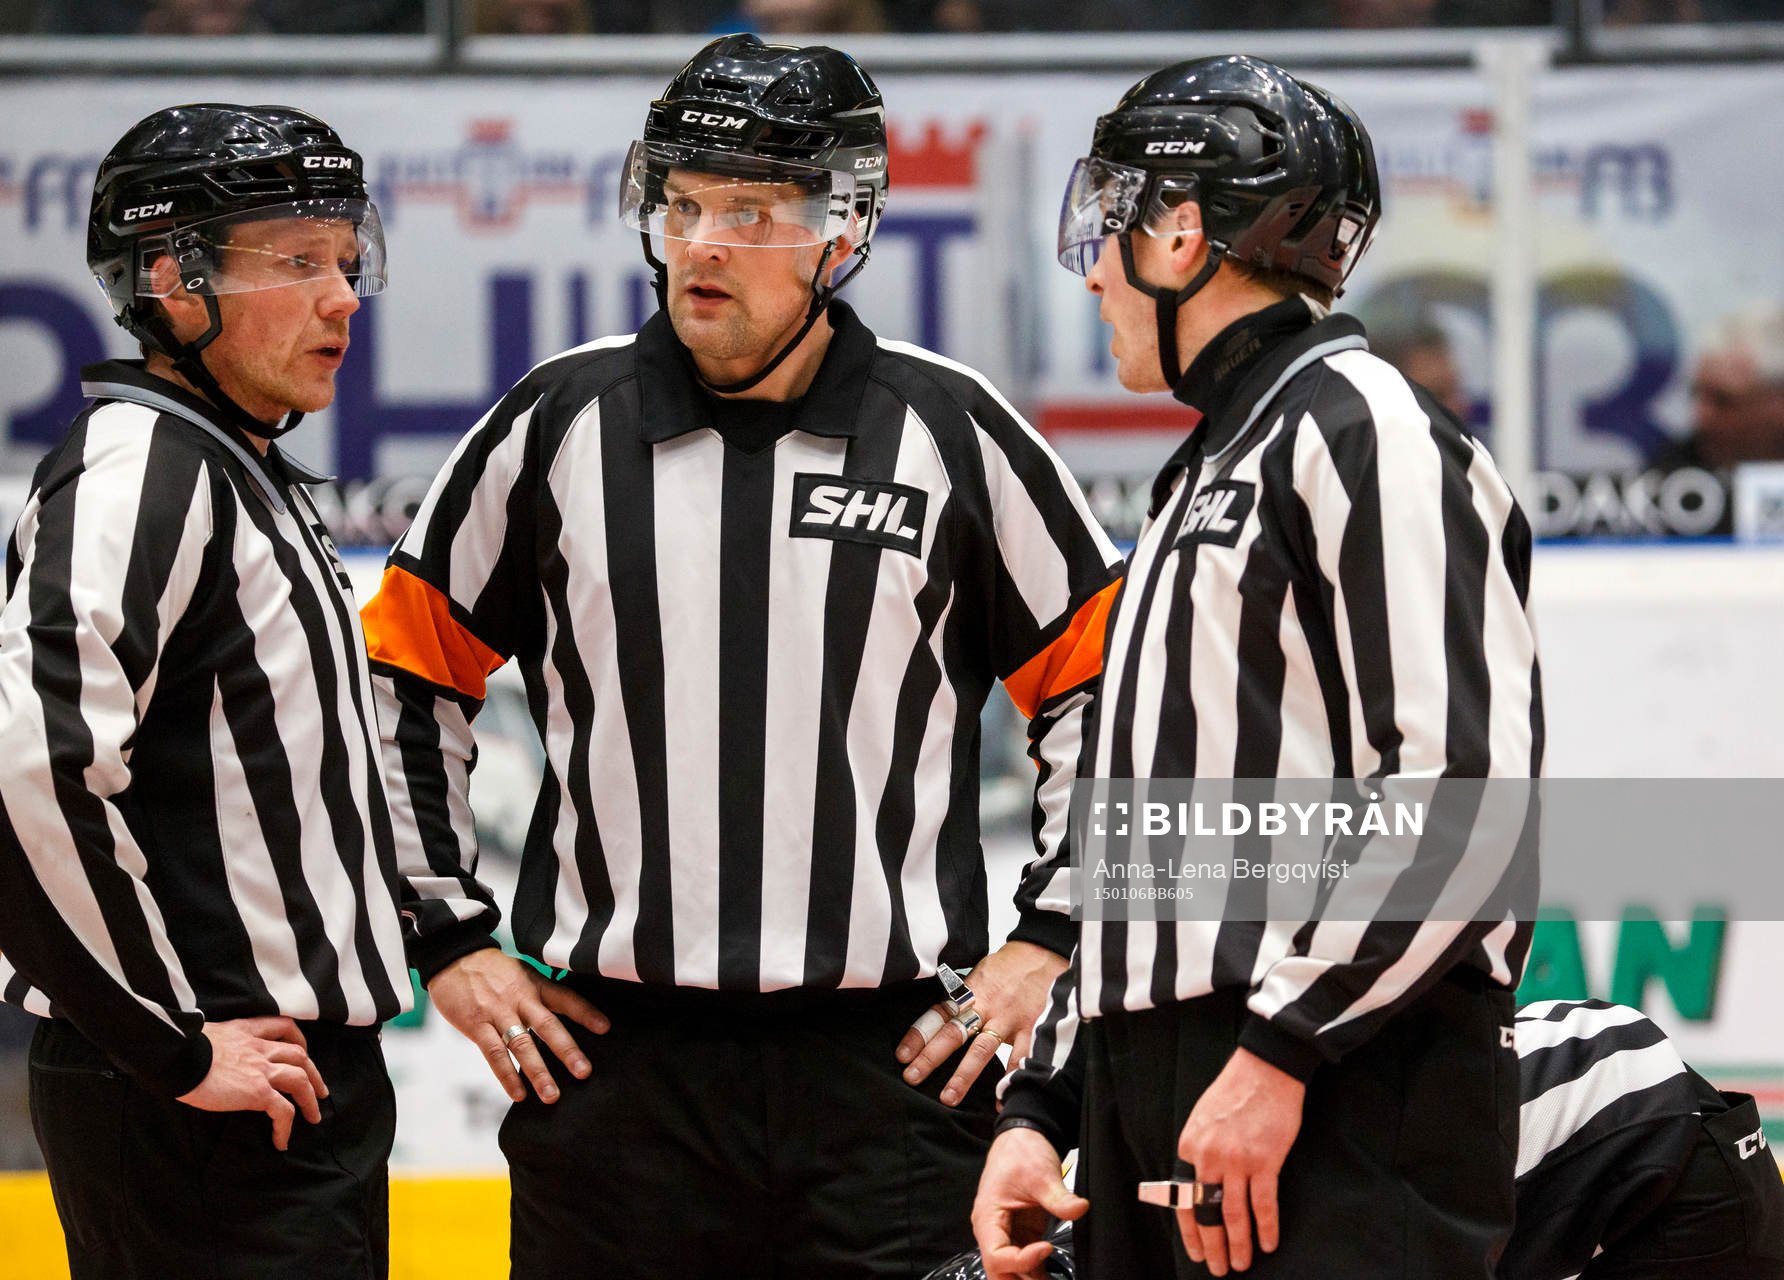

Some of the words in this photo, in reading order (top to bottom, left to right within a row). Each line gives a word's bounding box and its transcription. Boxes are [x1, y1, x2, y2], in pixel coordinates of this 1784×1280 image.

[682, 109, 749, 130] CCM
[1144, 141, 1206, 155] CCM
[302, 156, 352, 169] CCM
[853, 155, 884, 170] CCM
[123, 201, 174, 221] CCM
[800, 484, 918, 540] SHL
